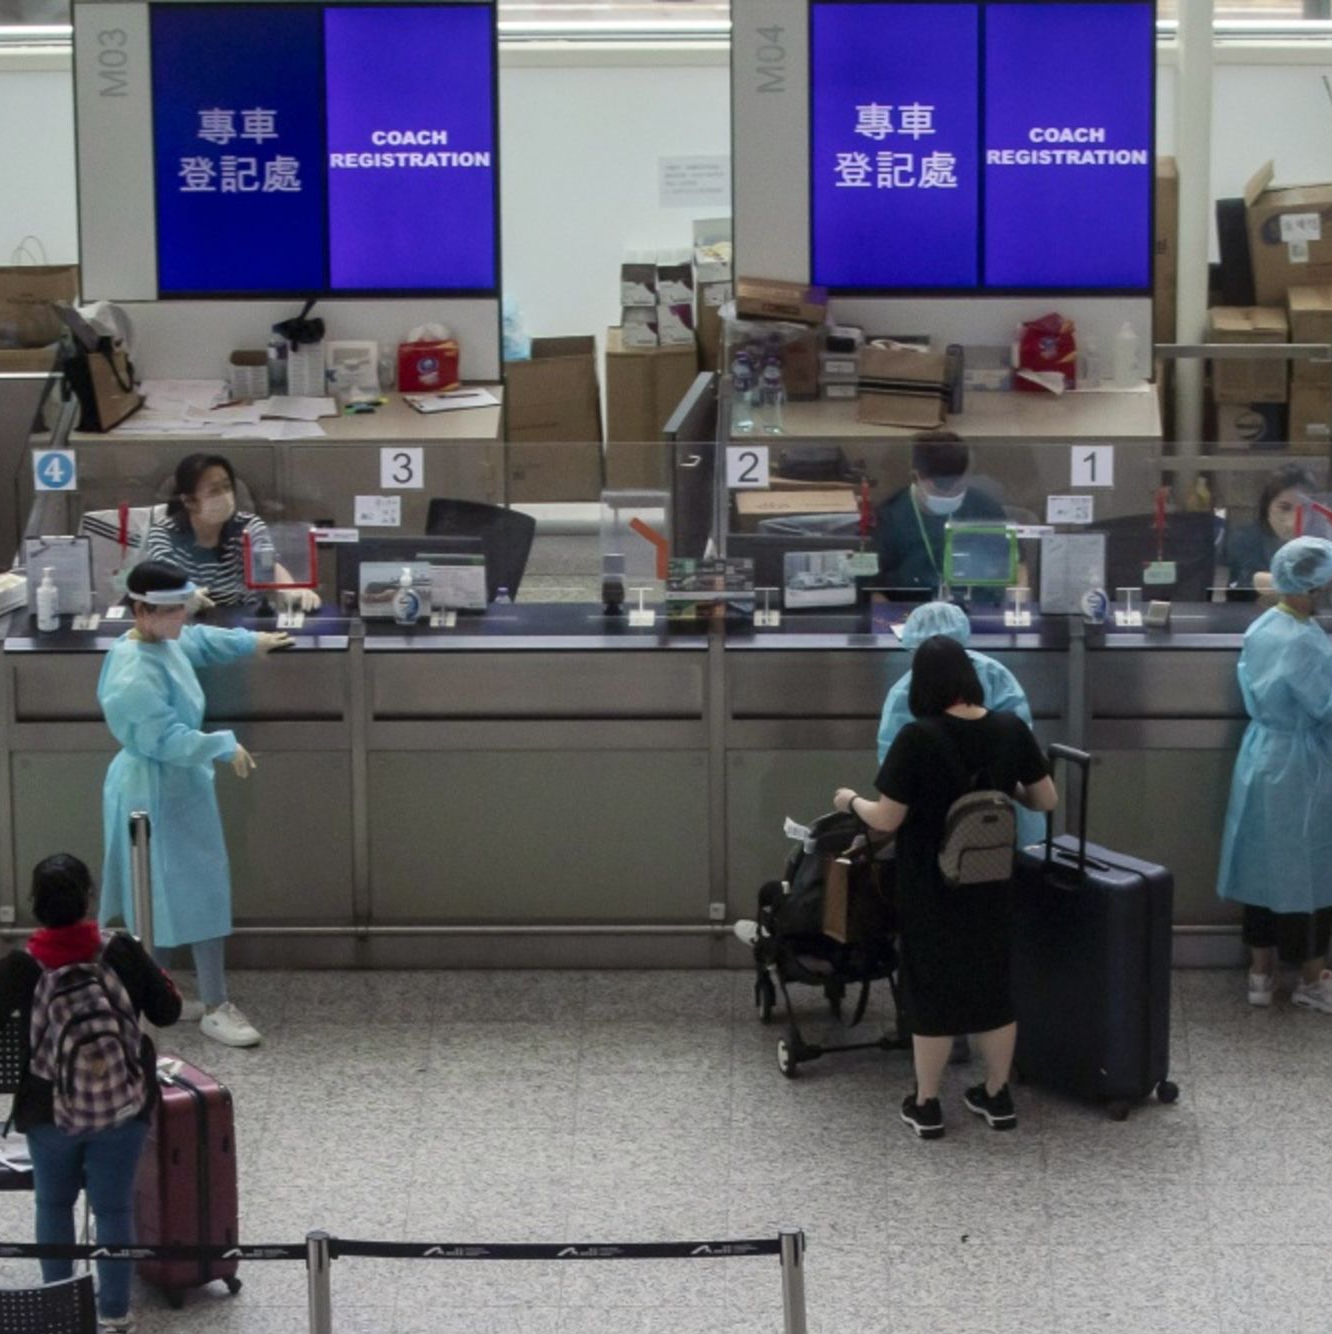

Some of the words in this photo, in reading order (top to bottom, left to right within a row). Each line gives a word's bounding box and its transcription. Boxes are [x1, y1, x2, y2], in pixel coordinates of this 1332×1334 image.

[97, 28, 128, 97] M03
[755, 25, 786, 93] M04
[198, 108, 279, 144] 專車
[854, 102, 936, 140] 專車
[1029, 128, 1104, 142] COACH
[372, 131, 447, 145] COACH
[330, 152, 490, 167] REGISTRATION
[834, 152, 958, 188] 登記處
[987, 150, 1146, 164] REGISTRATION
[178, 156, 302, 192] 登記處
[44, 457, 65, 482] 4
[392, 453, 413, 484] 3
[738, 452, 759, 482] 2
[1083, 452, 1096, 482] 1
